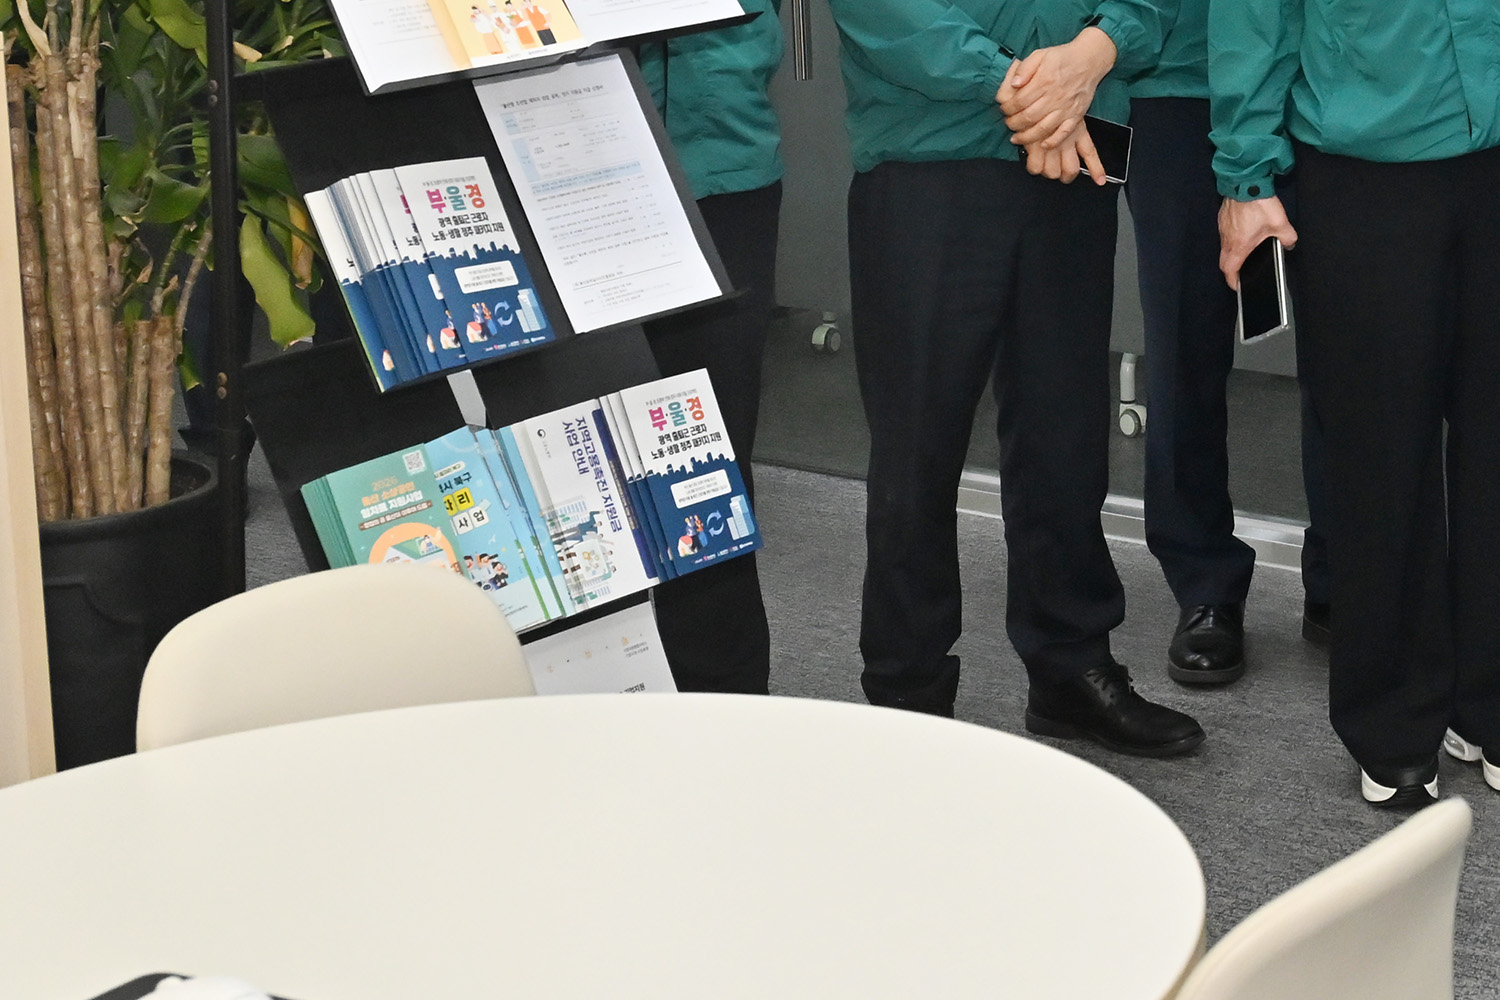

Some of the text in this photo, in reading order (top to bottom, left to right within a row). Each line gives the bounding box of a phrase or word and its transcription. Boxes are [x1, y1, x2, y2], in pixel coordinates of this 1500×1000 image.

[438, 212, 490, 228] 광역 출퇴근 근로자
[461, 226, 474, 237] 정주
[473, 224, 492, 235] 패키지
[492, 222, 506, 232] 지원
[658, 423, 708, 446] 광역 출퇴근 근로자
[680, 440, 692, 452] 정주
[692, 434, 710, 448] 패키지
[709, 432, 722, 442] 지원
[562, 420, 590, 476] 사업 안내
[453, 471, 472, 486] 북구
[575, 416, 610, 494] 지역고용촉진
[602, 494, 623, 533] 지원금
[458, 509, 486, 529] 사업
